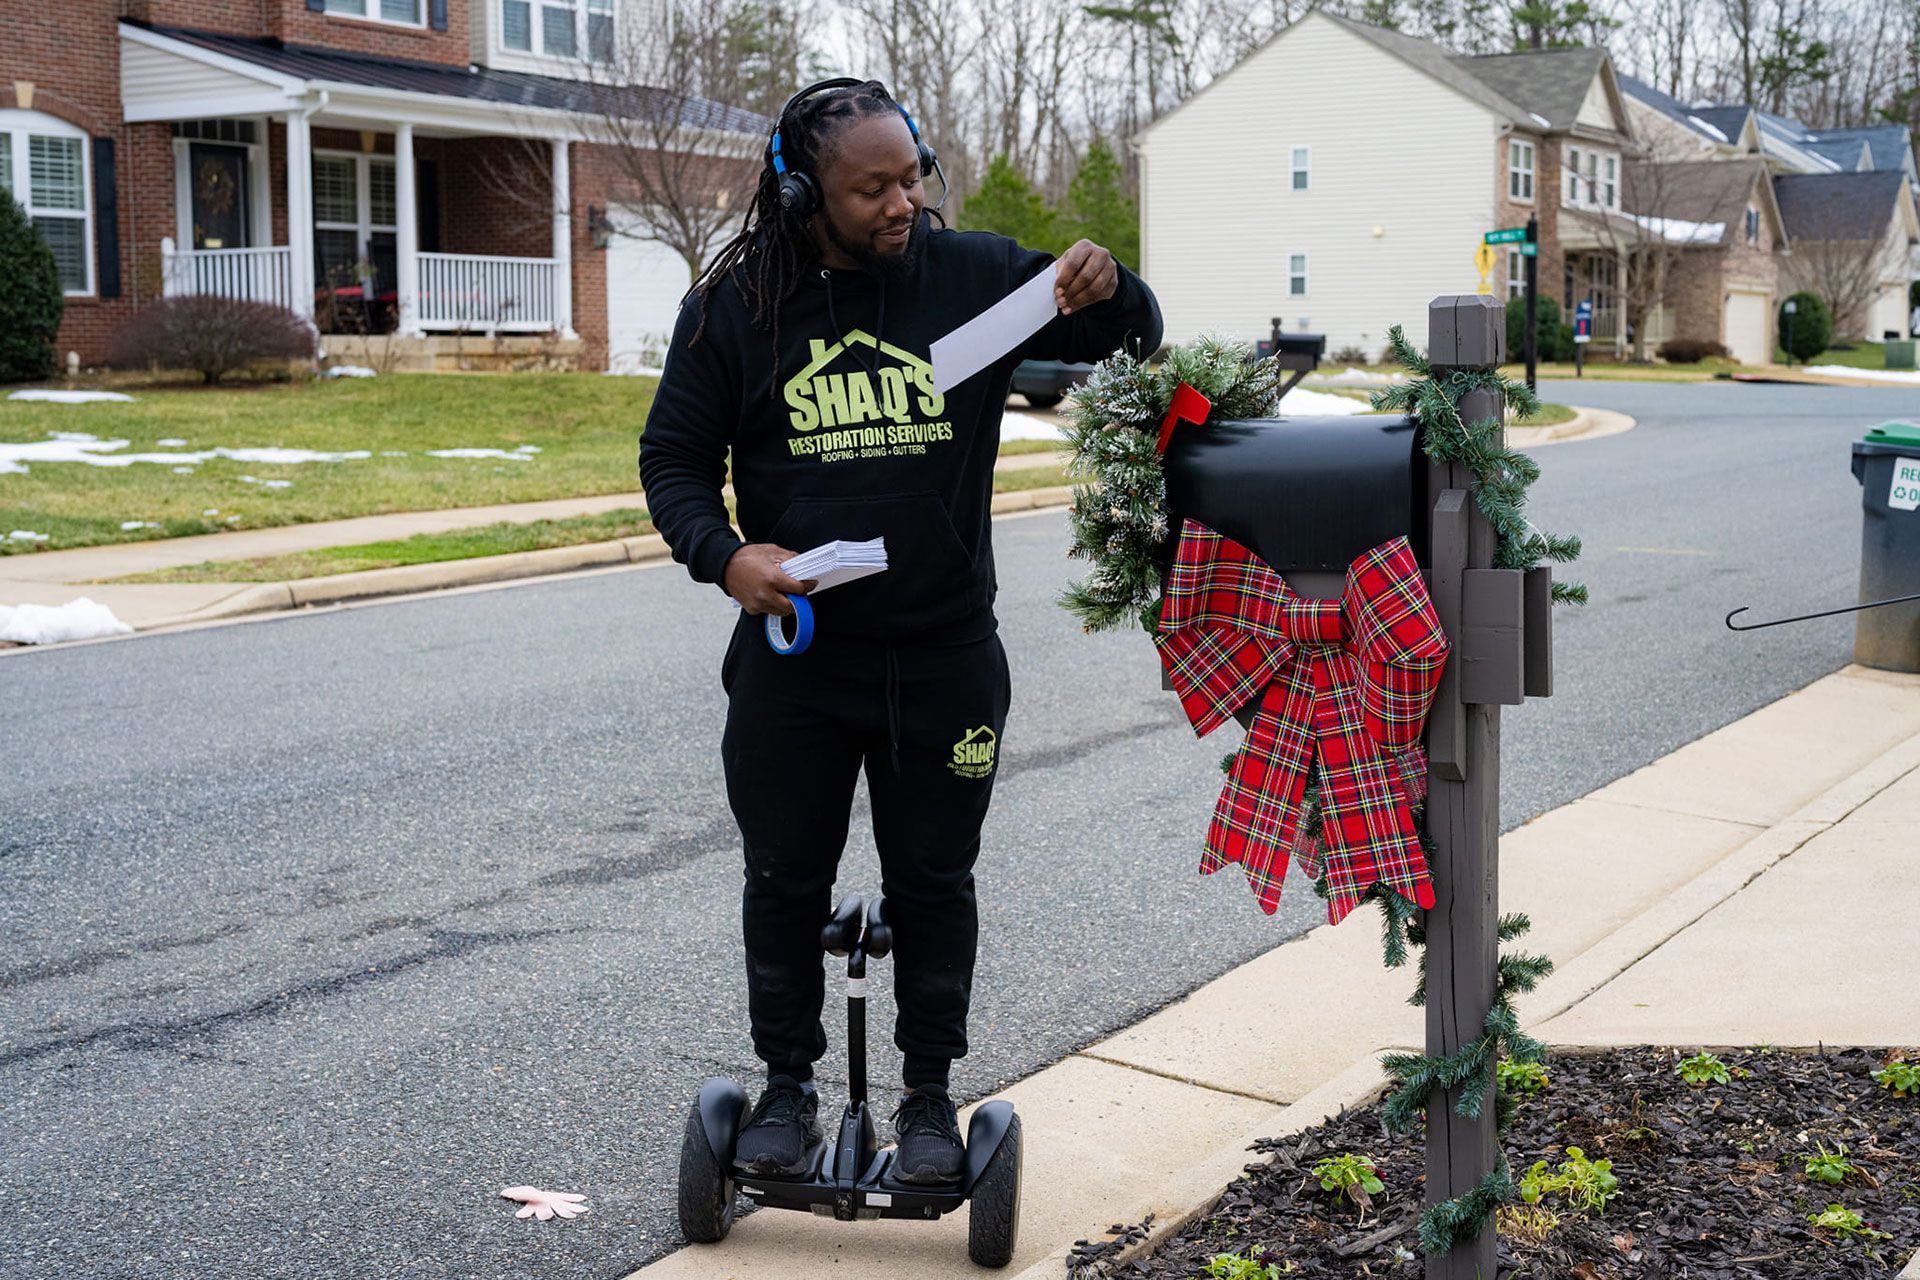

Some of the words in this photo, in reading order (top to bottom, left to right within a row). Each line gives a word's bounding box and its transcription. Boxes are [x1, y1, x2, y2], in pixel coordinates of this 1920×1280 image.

[783, 365, 945, 432] SHAQ'S
[788, 426, 885, 456] RESTORATION
[887, 422, 953, 445] SERVICES
[821, 449, 854, 463] ROOFING
[860, 446, 887, 458] SIDING
[892, 444, 926, 456] GUTTERS
[1909, 488, 1920, 501] O
